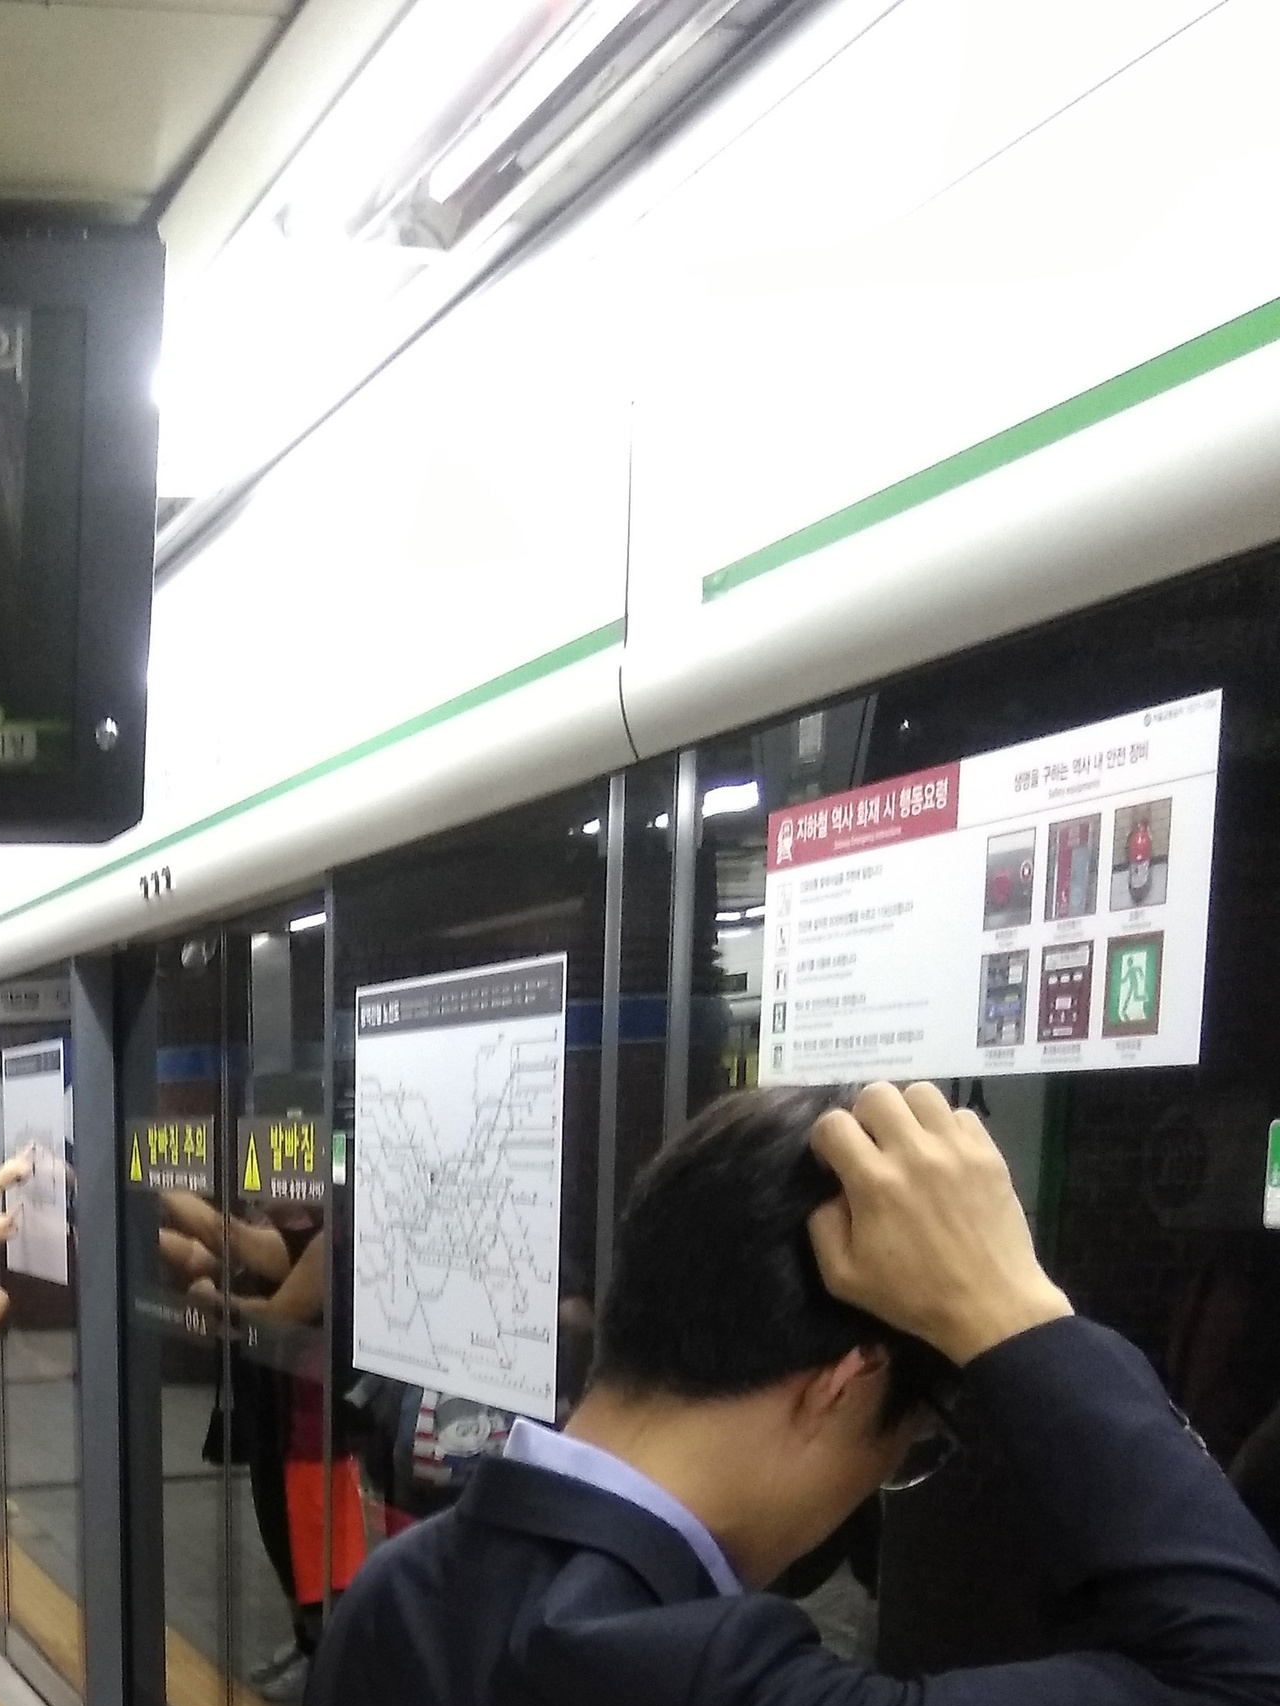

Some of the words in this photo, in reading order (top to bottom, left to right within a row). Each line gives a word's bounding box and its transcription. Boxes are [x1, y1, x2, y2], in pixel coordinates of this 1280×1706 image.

[1014, 768, 1039, 793] 생명을
[1043, 762, 1069, 785] 구하는
[1106, 746, 1126, 769] 안전
[1129, 740, 1150, 764] 장비
[796, 808, 828, 842] 지하철
[831, 802, 854, 833] 역사
[856, 796, 880, 828] 화재
[882, 790, 897, 821] 시
[899, 776, 949, 819] 행동요령
[184, 1123, 207, 1167] 주의
[270, 1121, 316, 1173] 발빠짐
